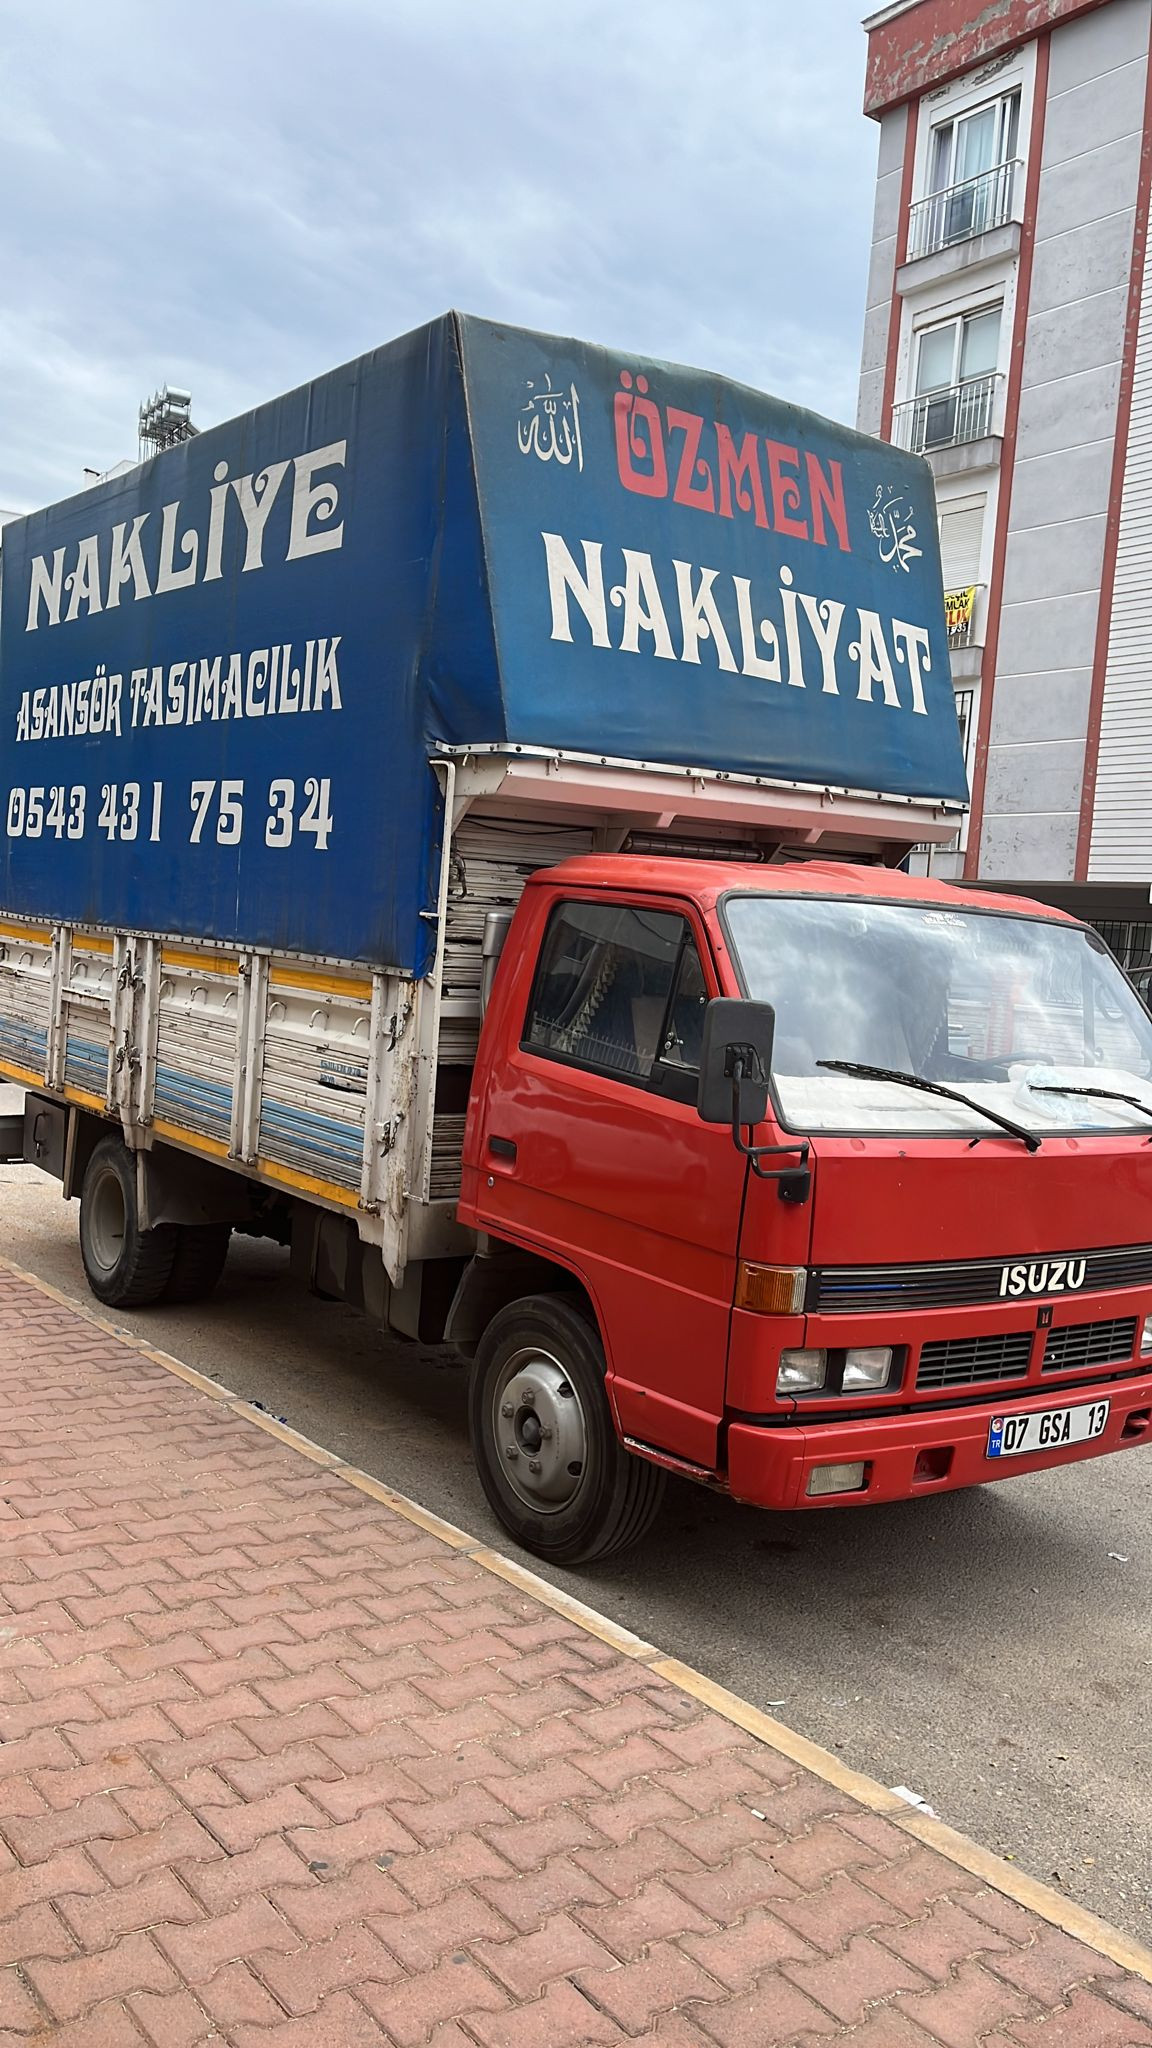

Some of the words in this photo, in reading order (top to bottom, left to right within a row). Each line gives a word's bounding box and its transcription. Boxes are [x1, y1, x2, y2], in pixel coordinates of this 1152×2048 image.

[613, 369, 852, 552] ÖZMEN
[25, 440, 347, 631] NAKLİYE
[541, 532, 931, 715] NAKLİYAT
[16, 664, 122, 742] ASANSÖR
[131, 636, 343, 728] TASIMACILIK
[6, 785, 87, 840] 0543
[190, 780, 244, 845] 75
[265, 778, 333, 850] 34
[999, 1260, 1086, 1296] ISUZU
[991, 1439, 1001, 1449] TR
[1004, 1417, 1030, 1450] 07
[1039, 1411, 1071, 1445] GSA
[1088, 1404, 1106, 1436] 13
